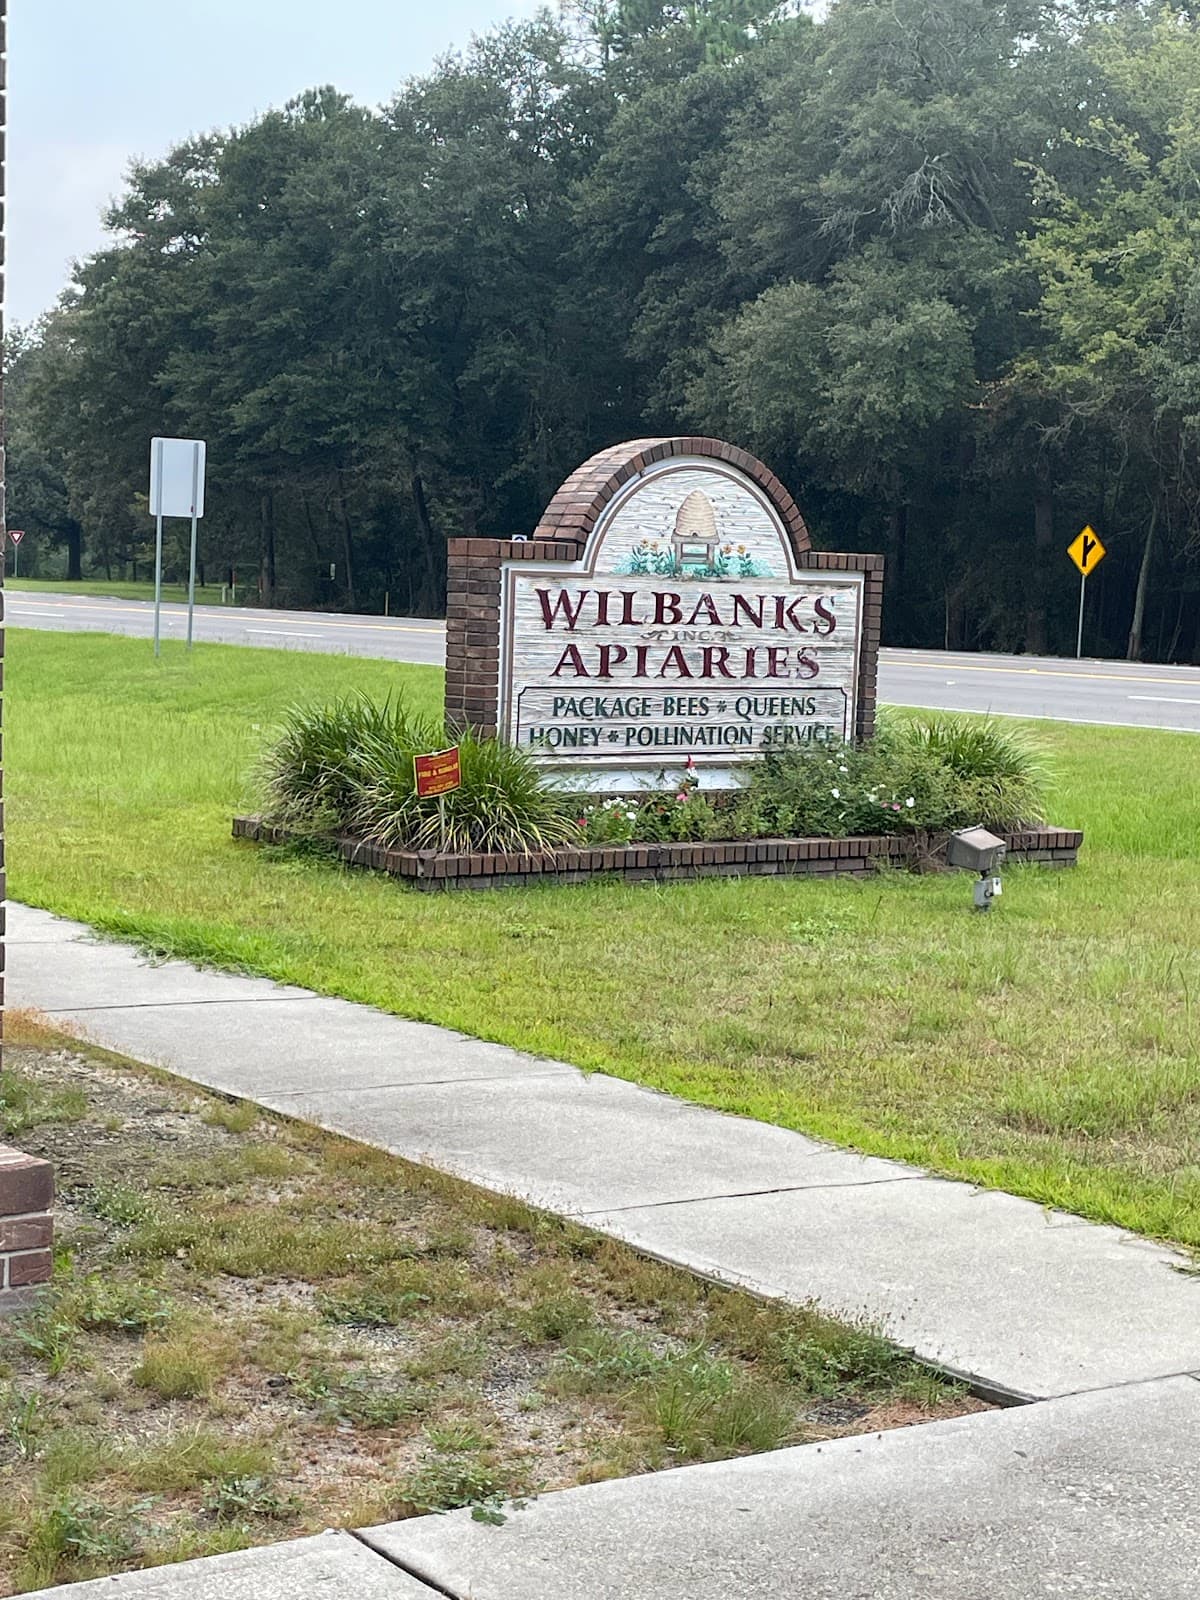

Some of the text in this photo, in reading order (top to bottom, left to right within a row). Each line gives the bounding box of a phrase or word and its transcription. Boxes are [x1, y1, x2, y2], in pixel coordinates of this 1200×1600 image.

[535, 588, 837, 636] WILBANKS
[550, 643, 820, 680] APIARIES
[552, 696, 816, 721] PACKAGE BEES QUEENS
[529, 725, 834, 747] HONEY POLLINATION SERVICE
